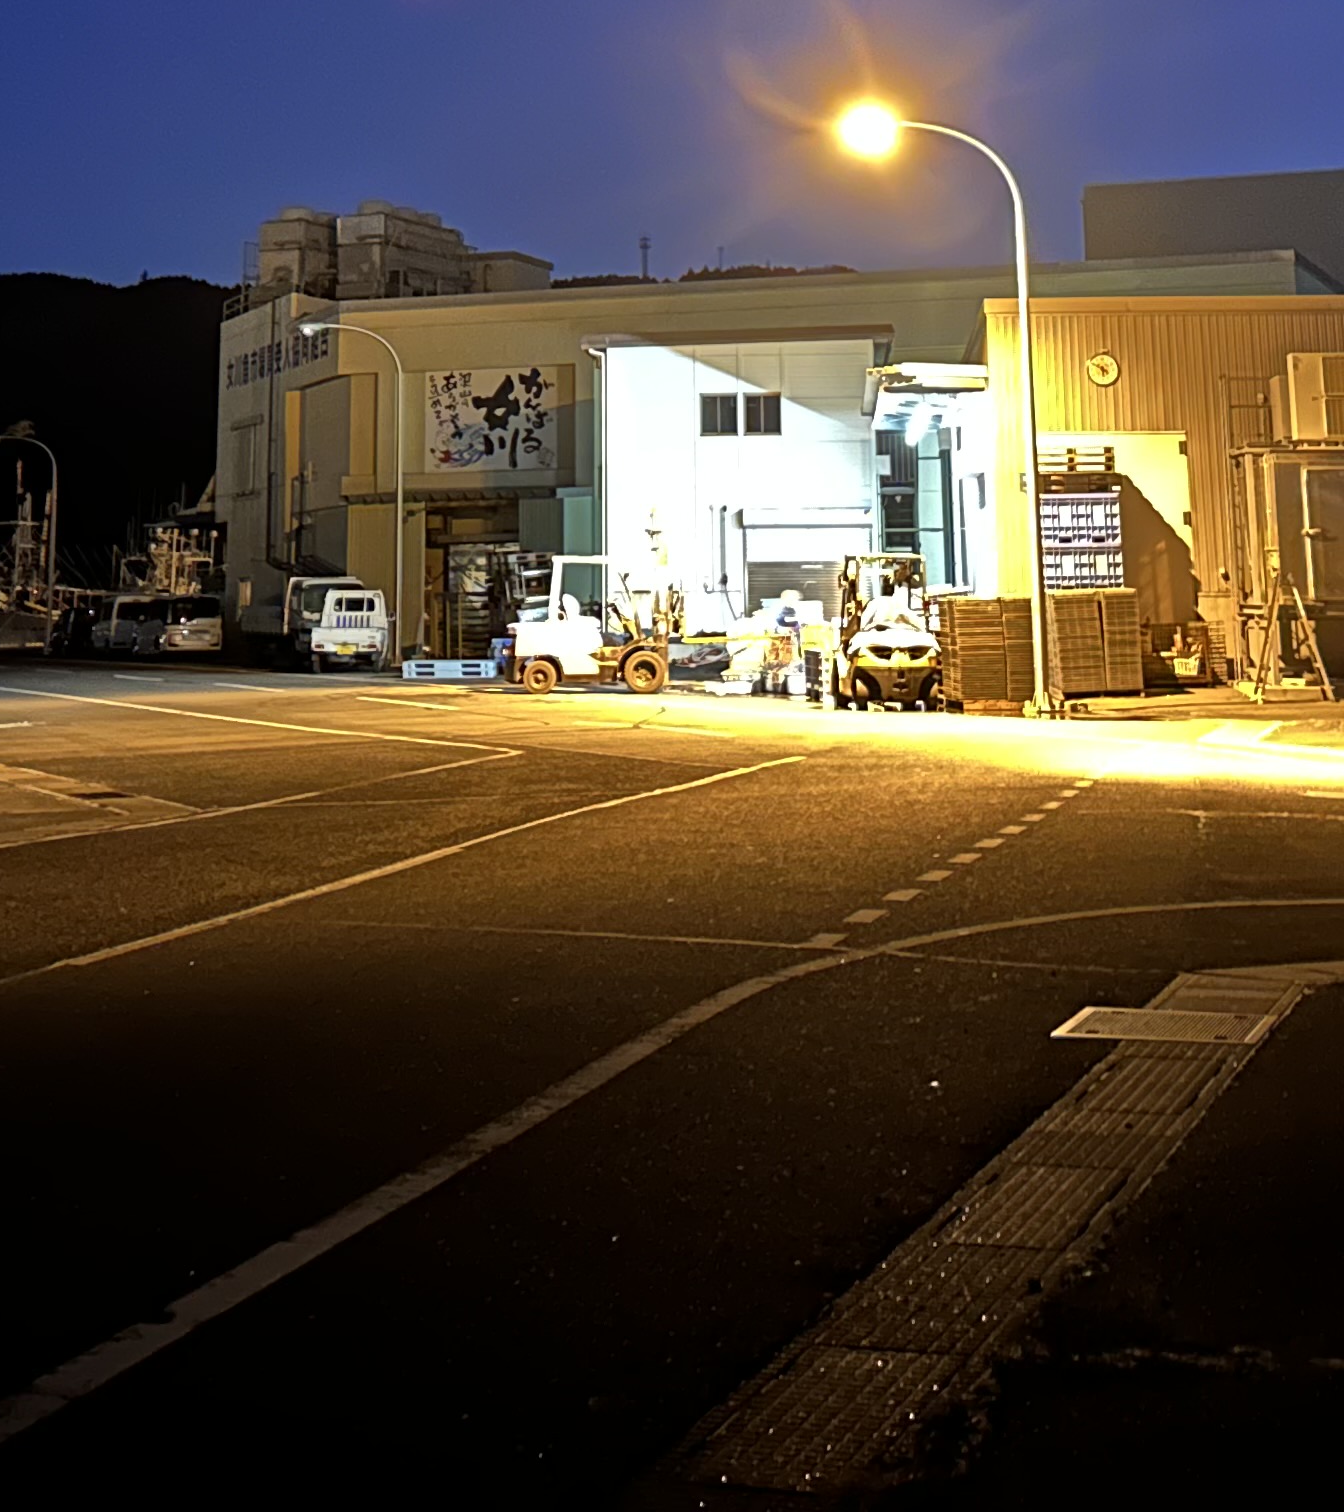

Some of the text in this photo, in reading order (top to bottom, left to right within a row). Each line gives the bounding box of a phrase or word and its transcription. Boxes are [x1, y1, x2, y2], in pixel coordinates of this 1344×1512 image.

[471, 374, 520, 468] 女川
[519, 367, 555, 454] がんばる
